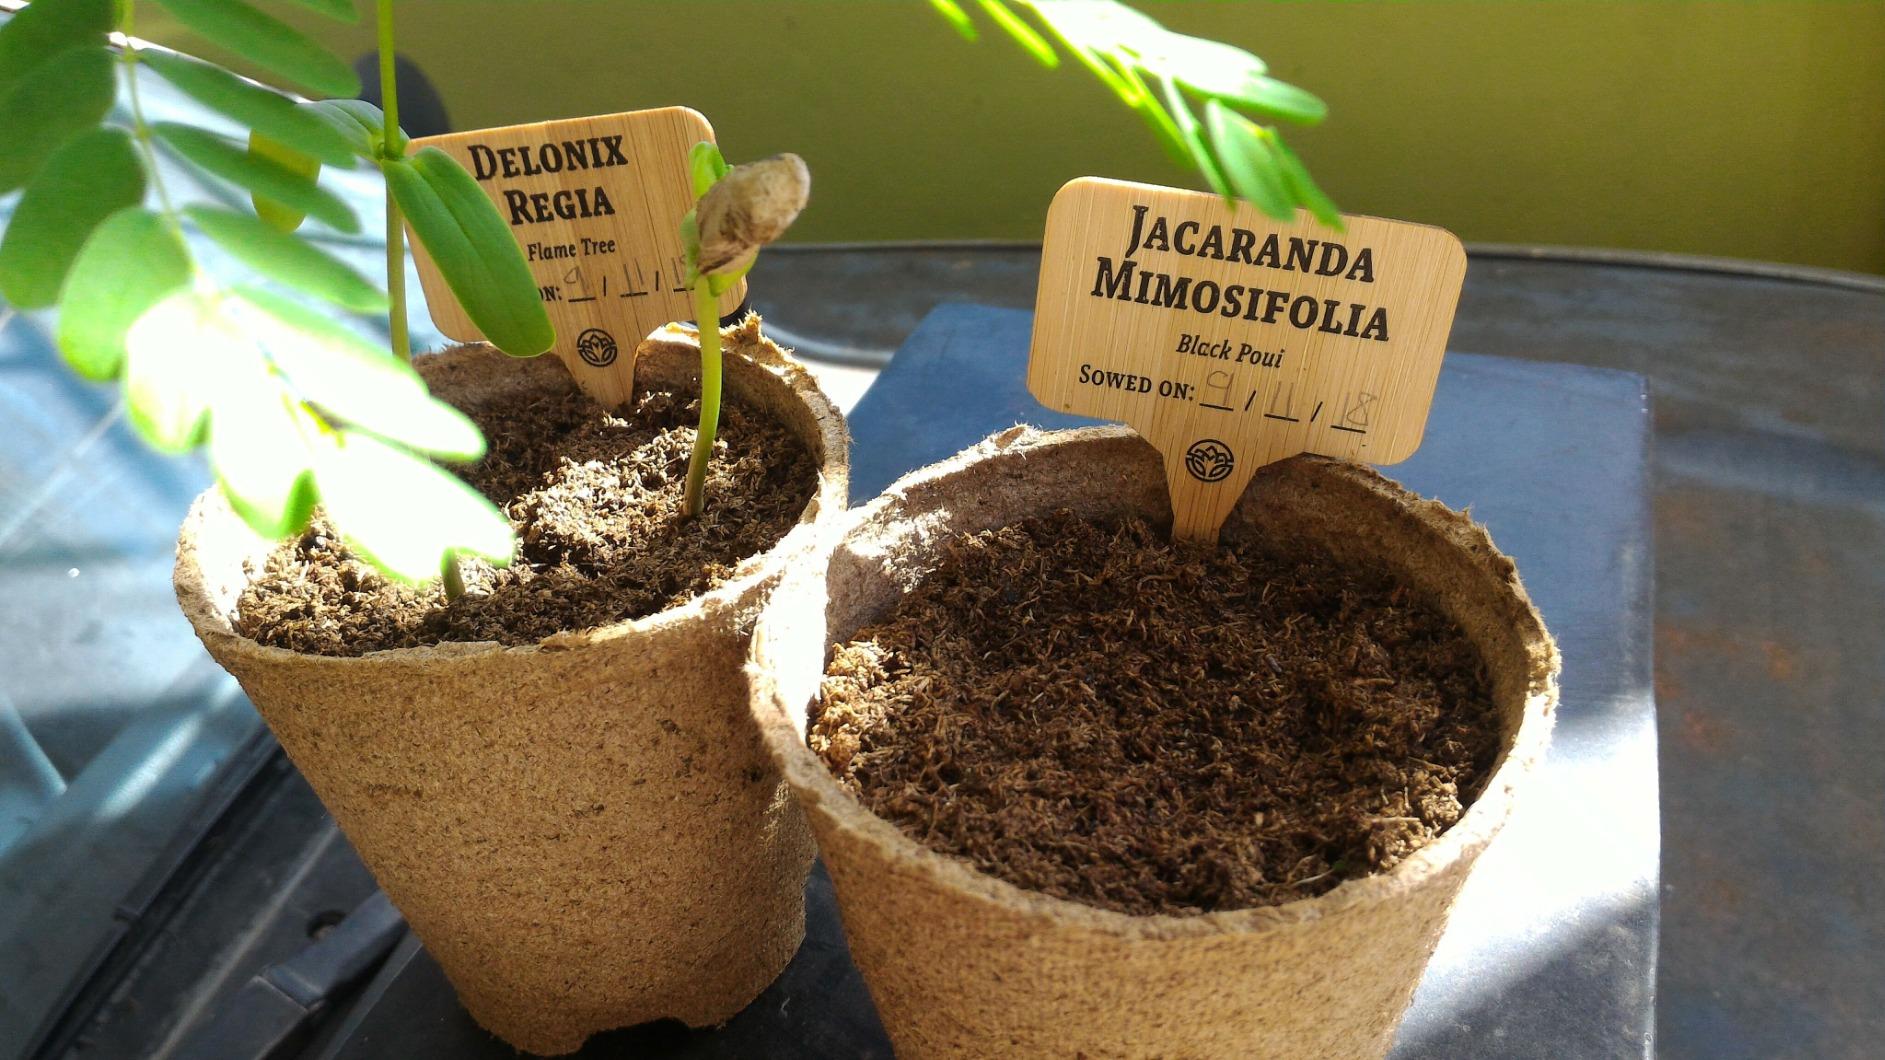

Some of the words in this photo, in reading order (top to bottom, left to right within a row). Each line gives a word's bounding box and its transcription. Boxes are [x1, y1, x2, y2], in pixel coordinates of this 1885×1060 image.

[467, 135, 628, 181] DELONIX
[503, 186, 616, 226] REGIA
[527, 242, 577, 261] Flame
[580, 237, 616, 256] Tree
[1125, 205, 1375, 283] JACARANDA
[538, 285, 563, 302] N:
[1091, 256, 1389, 341] MIMOSIFOLIA
[1176, 334, 1232, 360] Black
[1235, 343, 1285, 369] Poui
[1079, 364, 1152, 393] SOWED
[1158, 380, 1195, 401] ON:
